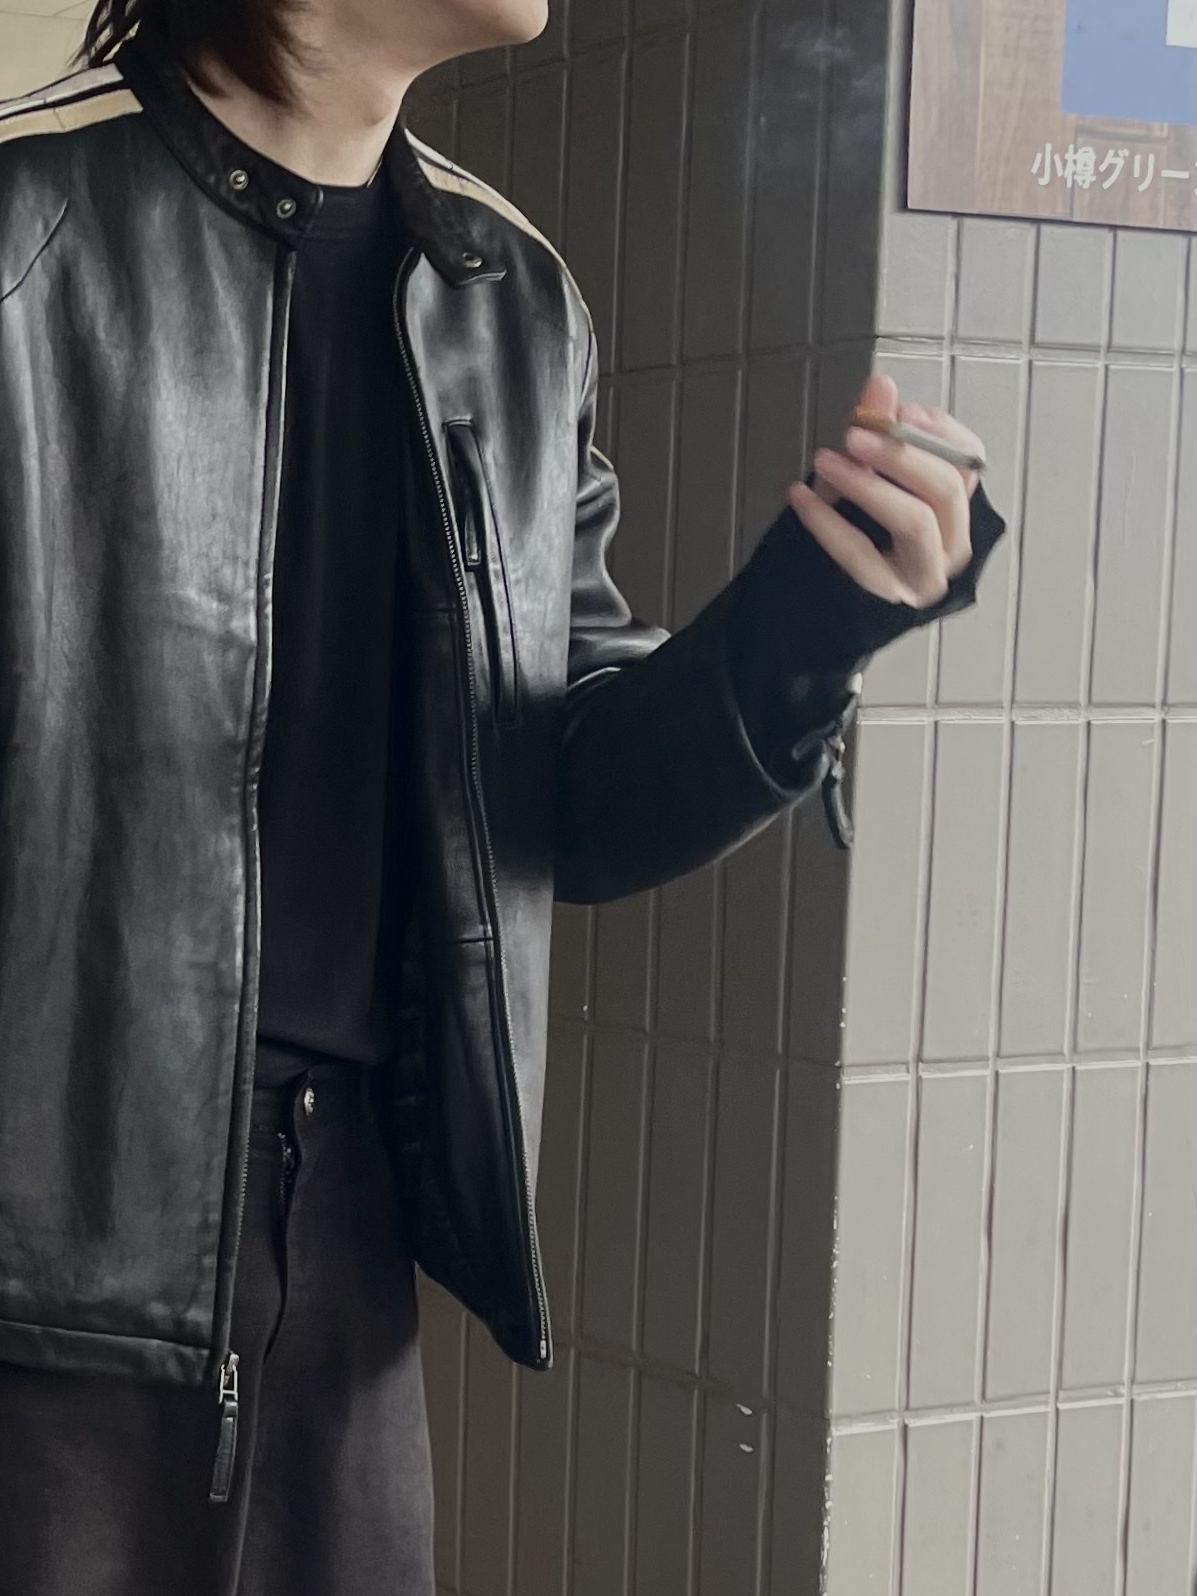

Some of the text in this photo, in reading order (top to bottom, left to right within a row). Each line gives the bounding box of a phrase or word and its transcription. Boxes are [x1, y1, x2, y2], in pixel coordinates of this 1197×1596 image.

[1030, 142, 1197, 196] 小樽グリー
